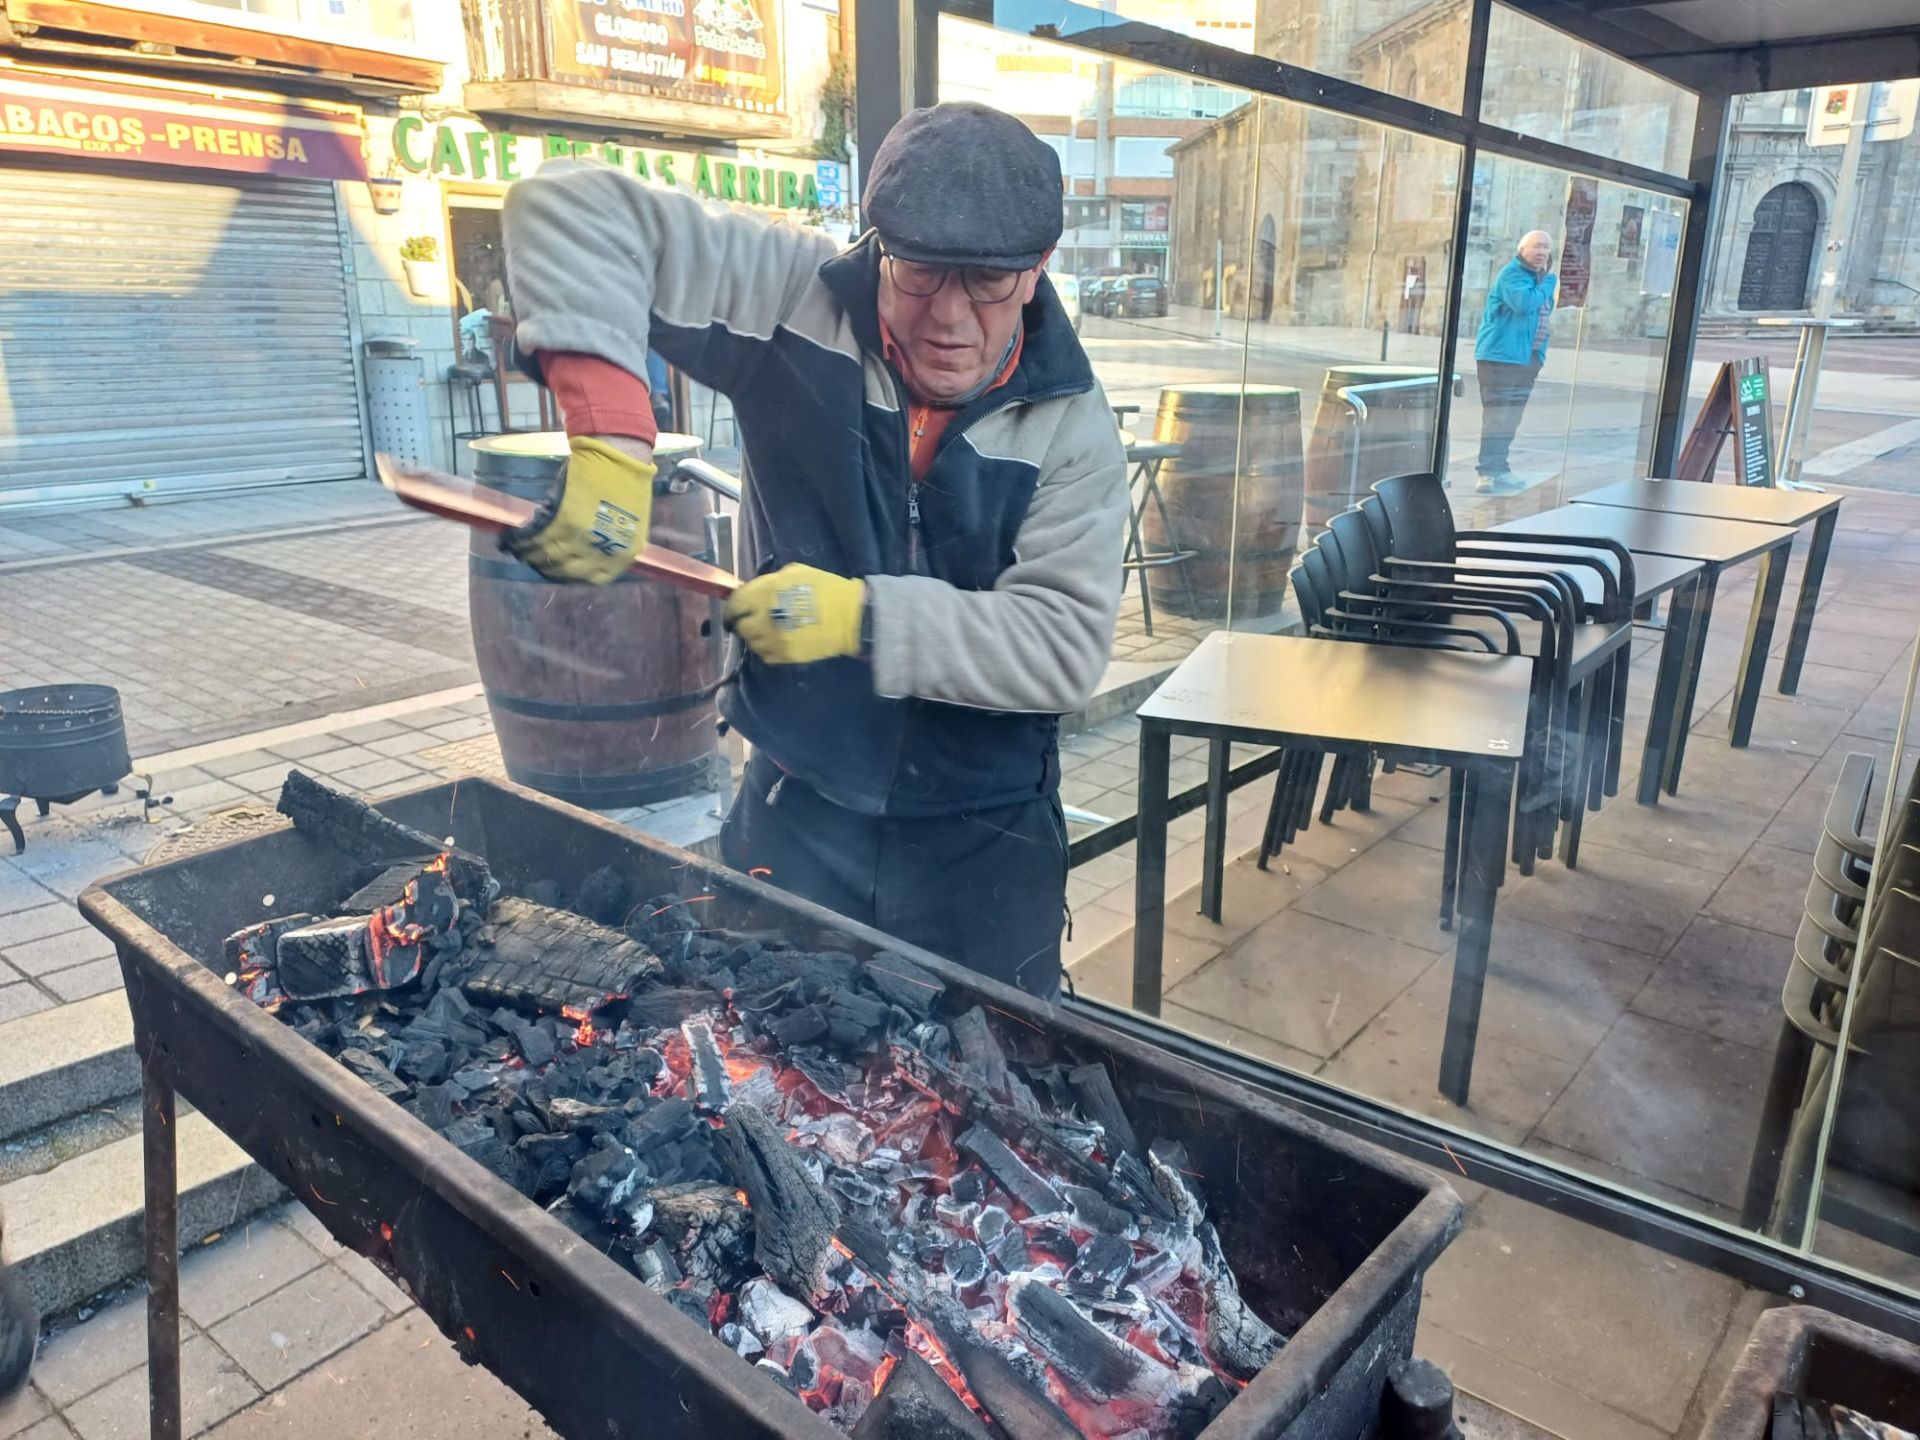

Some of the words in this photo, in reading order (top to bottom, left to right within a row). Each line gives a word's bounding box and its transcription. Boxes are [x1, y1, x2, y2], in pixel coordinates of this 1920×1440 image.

[575, 41, 608, 67] SAN
[610, 46, 686, 79] SEBASTIÁN
[693, 151, 821, 210] ARRIBA
